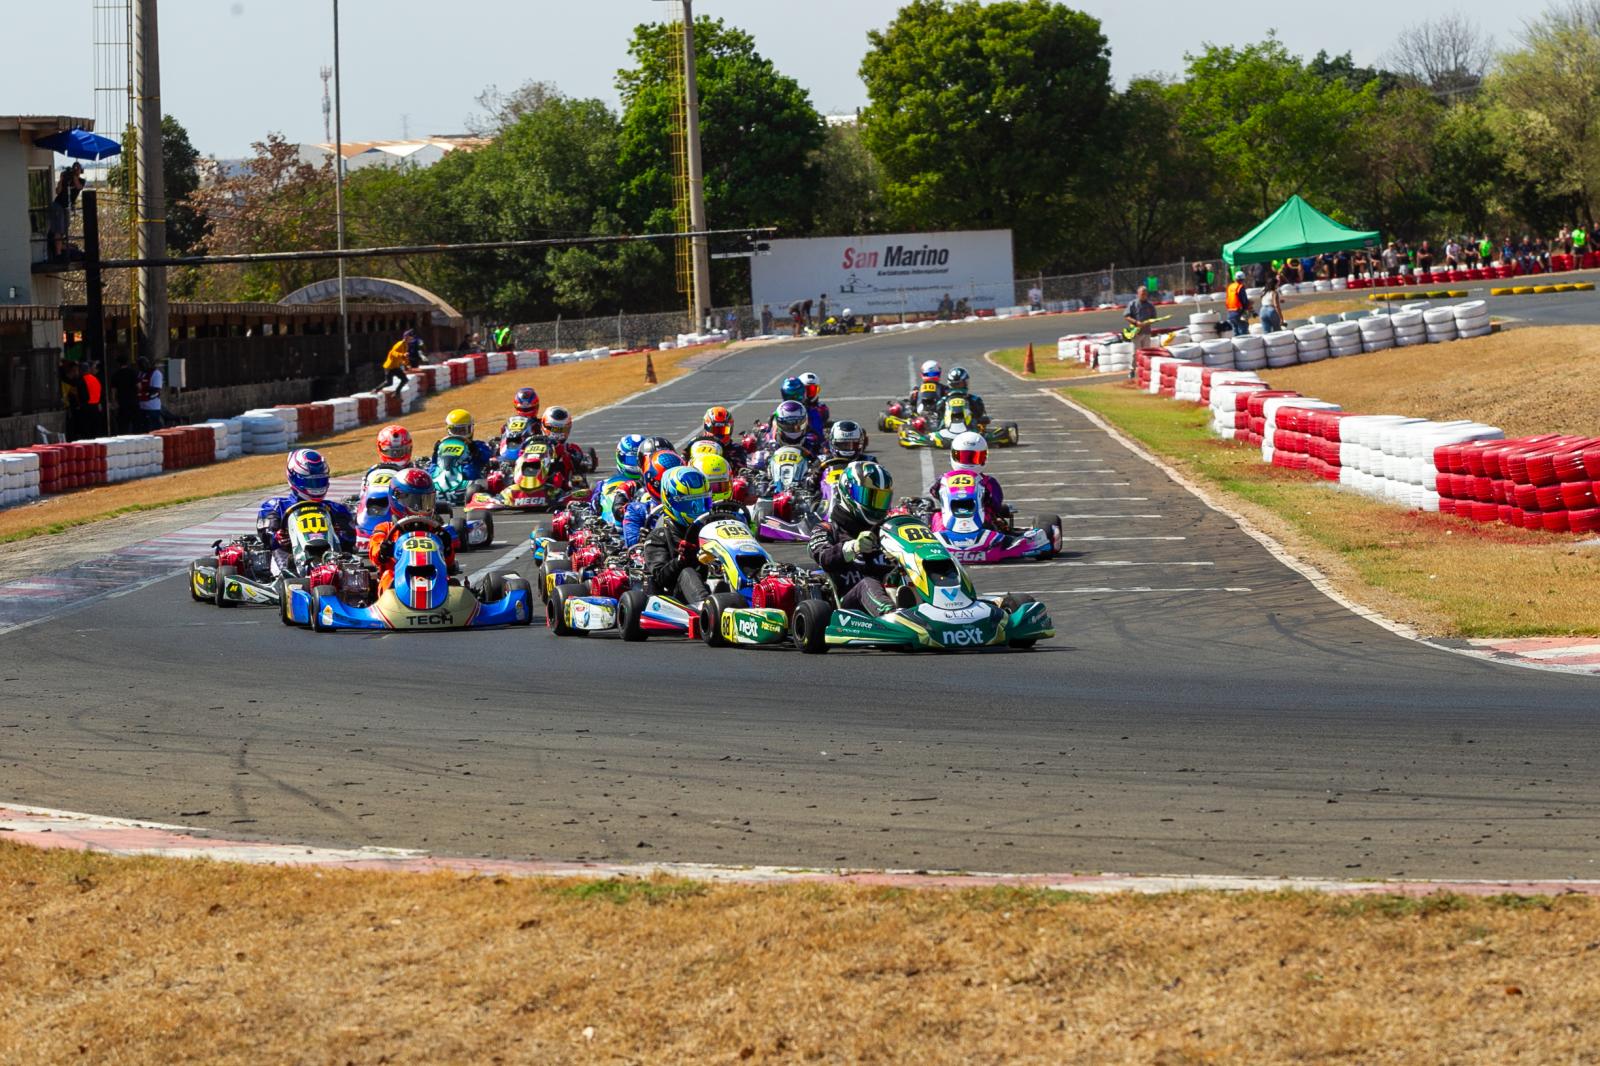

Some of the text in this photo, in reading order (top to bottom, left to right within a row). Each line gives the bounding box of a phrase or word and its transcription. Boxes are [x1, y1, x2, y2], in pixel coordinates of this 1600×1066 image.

[842, 244, 949, 270] San Marino
[952, 476, 971, 485] 45
[514, 497, 546, 505] MEGA
[302, 517, 327, 529] 111
[722, 526, 748, 537] 195
[405, 540, 433, 549] 95
[408, 615, 454, 625] TECH
[739, 618, 759, 637] next
[943, 628, 984, 645] next
